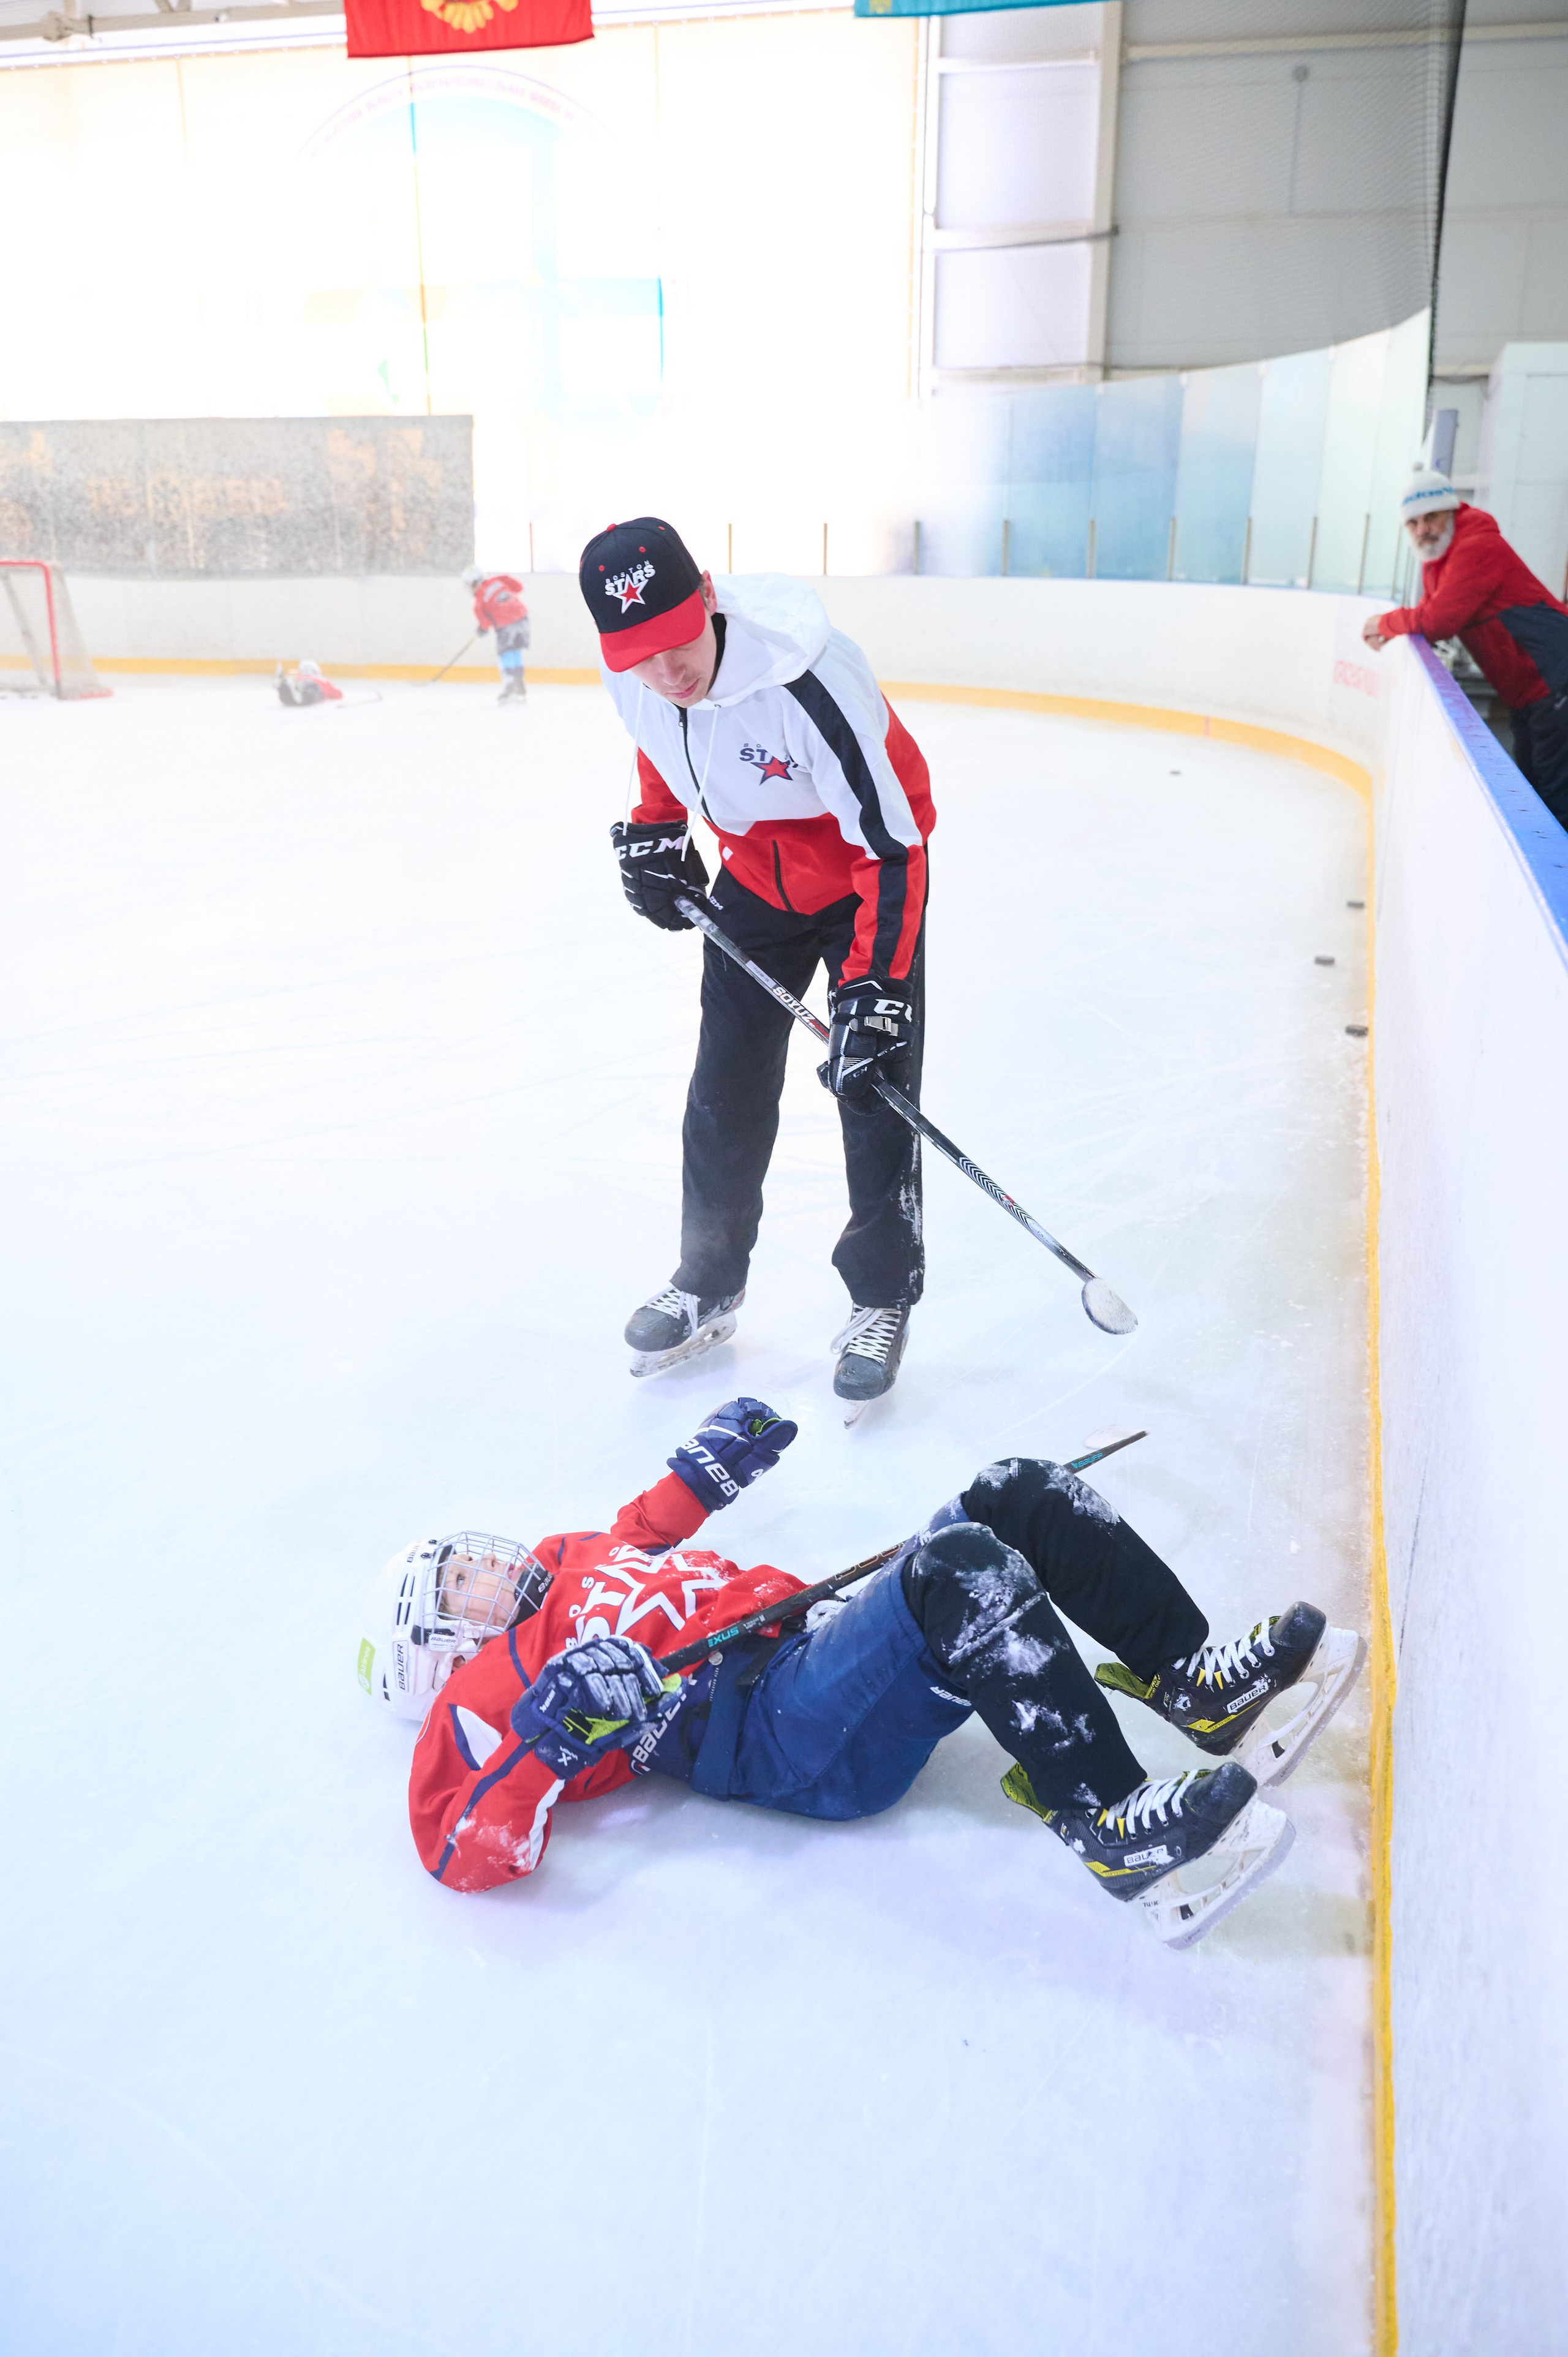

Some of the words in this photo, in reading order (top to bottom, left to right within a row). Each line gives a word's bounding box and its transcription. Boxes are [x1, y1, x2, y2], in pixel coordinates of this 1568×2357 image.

[615, 835, 685, 861] CCM
[772, 986, 816, 1024] SOYUZ
[680, 1438, 739, 1497] BAUE
[407, 1539, 423, 1563] BAU
[537, 1572, 554, 1593] BAU
[397, 1643, 406, 1691] BAUER
[1229, 1684, 1267, 1711] BAUER
[1126, 1848, 1164, 1864] BAU
